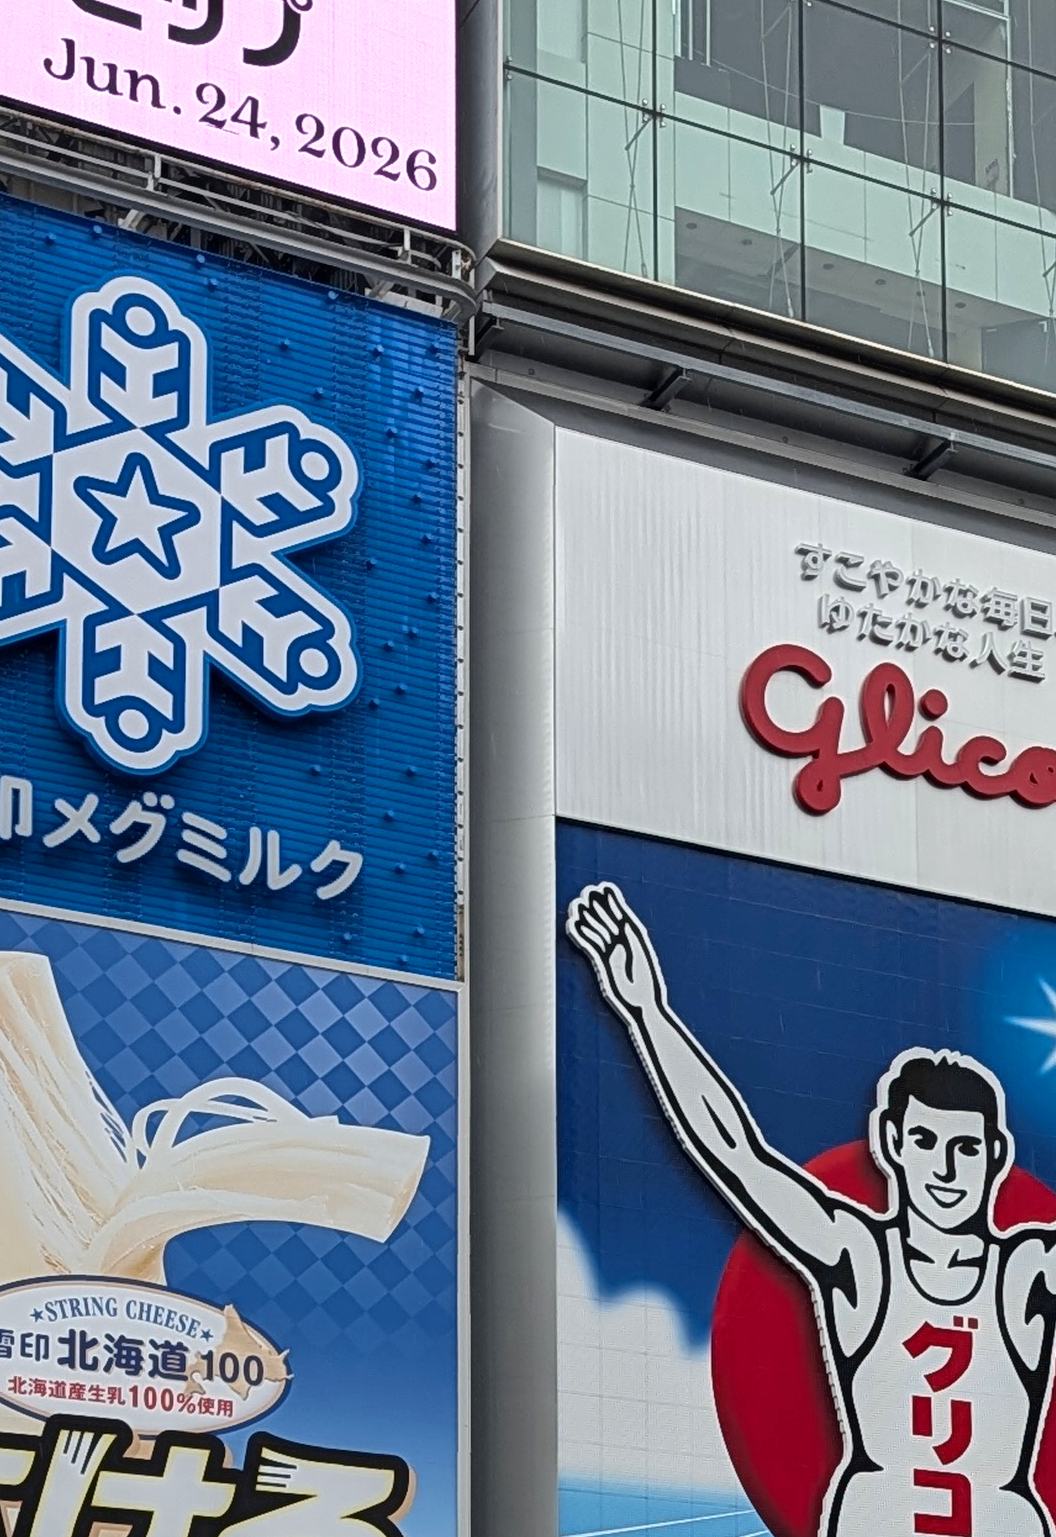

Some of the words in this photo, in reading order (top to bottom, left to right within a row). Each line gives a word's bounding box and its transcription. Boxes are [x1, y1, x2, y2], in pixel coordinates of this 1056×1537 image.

[43, 38, 182, 115] Jun.
[195, 82, 281, 151] 24,
[295, 113, 437, 192] 2026
[818, 594, 1046, 682] ゆたかな人生
[44, 1296, 118, 1323] STRING
[125, 1298, 202, 1340] CHEESE
[7, 1375, 234, 1418] 北海道産生乳100%使用
[901, 1315, 979, 1537] グリコ
